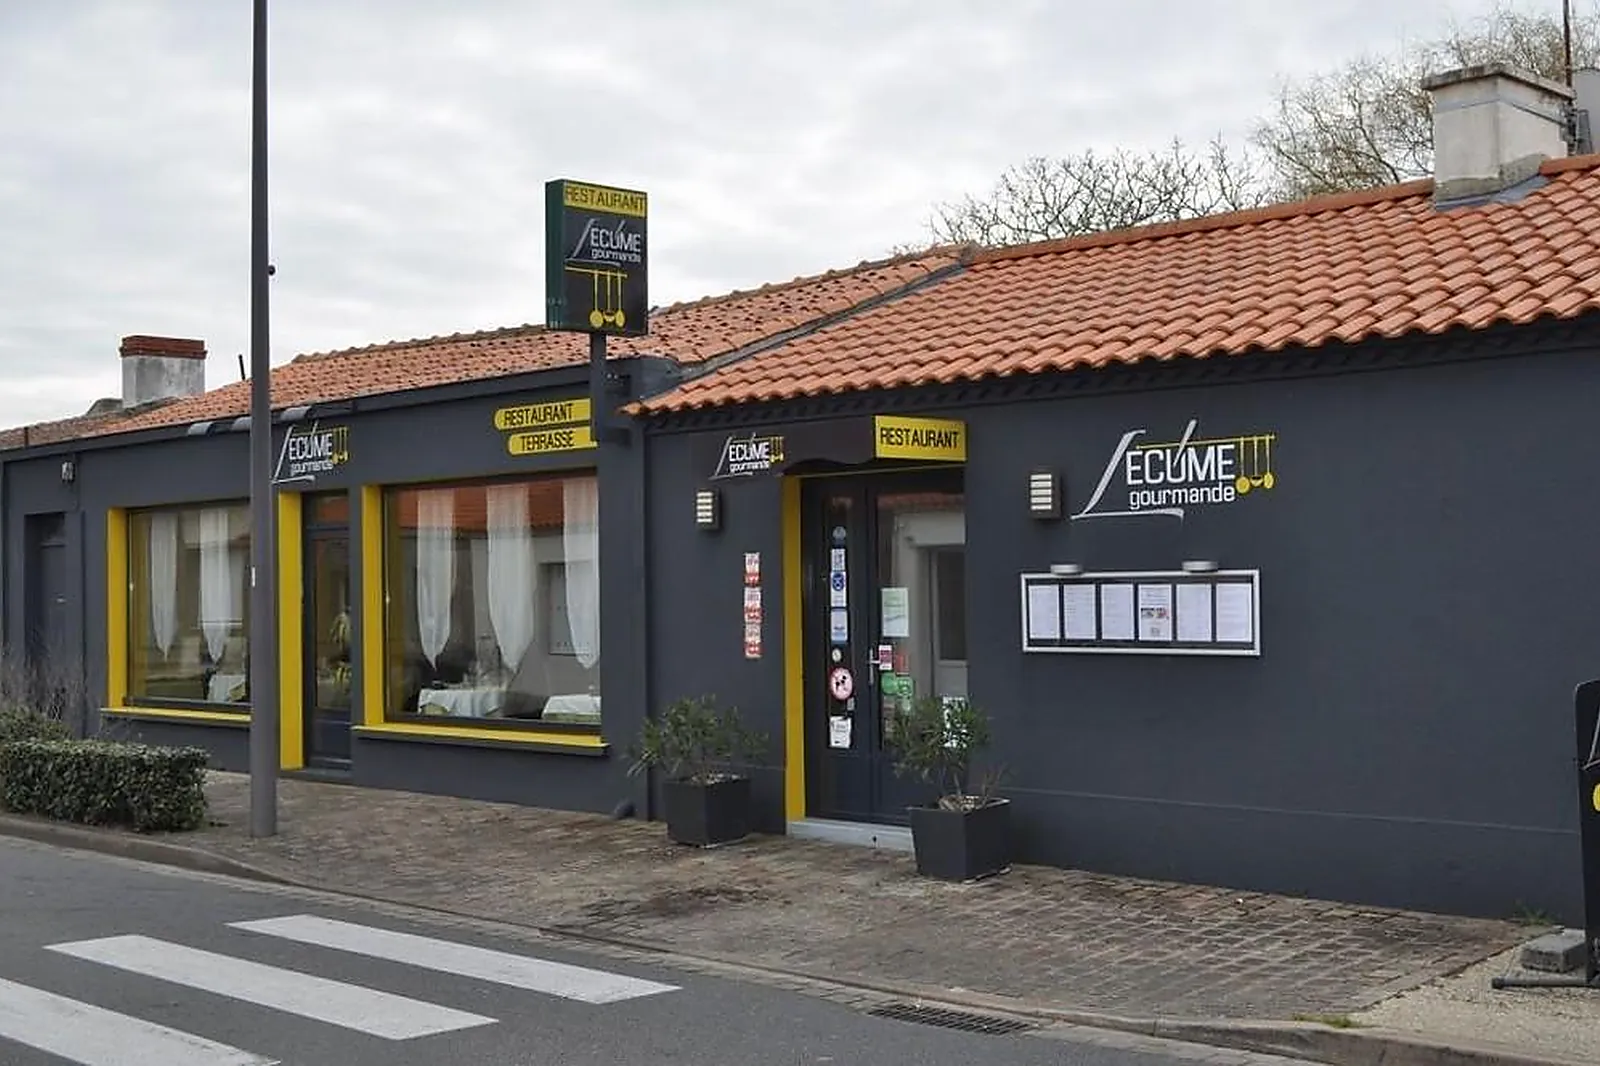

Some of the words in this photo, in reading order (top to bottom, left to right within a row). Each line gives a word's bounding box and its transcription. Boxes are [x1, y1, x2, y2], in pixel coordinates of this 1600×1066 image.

[565, 184, 645, 212] RESTAURANT
[503, 403, 573, 426] RESTAURANT
[520, 430, 575, 451] TERRASSE
[880, 427, 959, 449] RESTAURANT
[1129, 482, 1236, 510] gourmande
